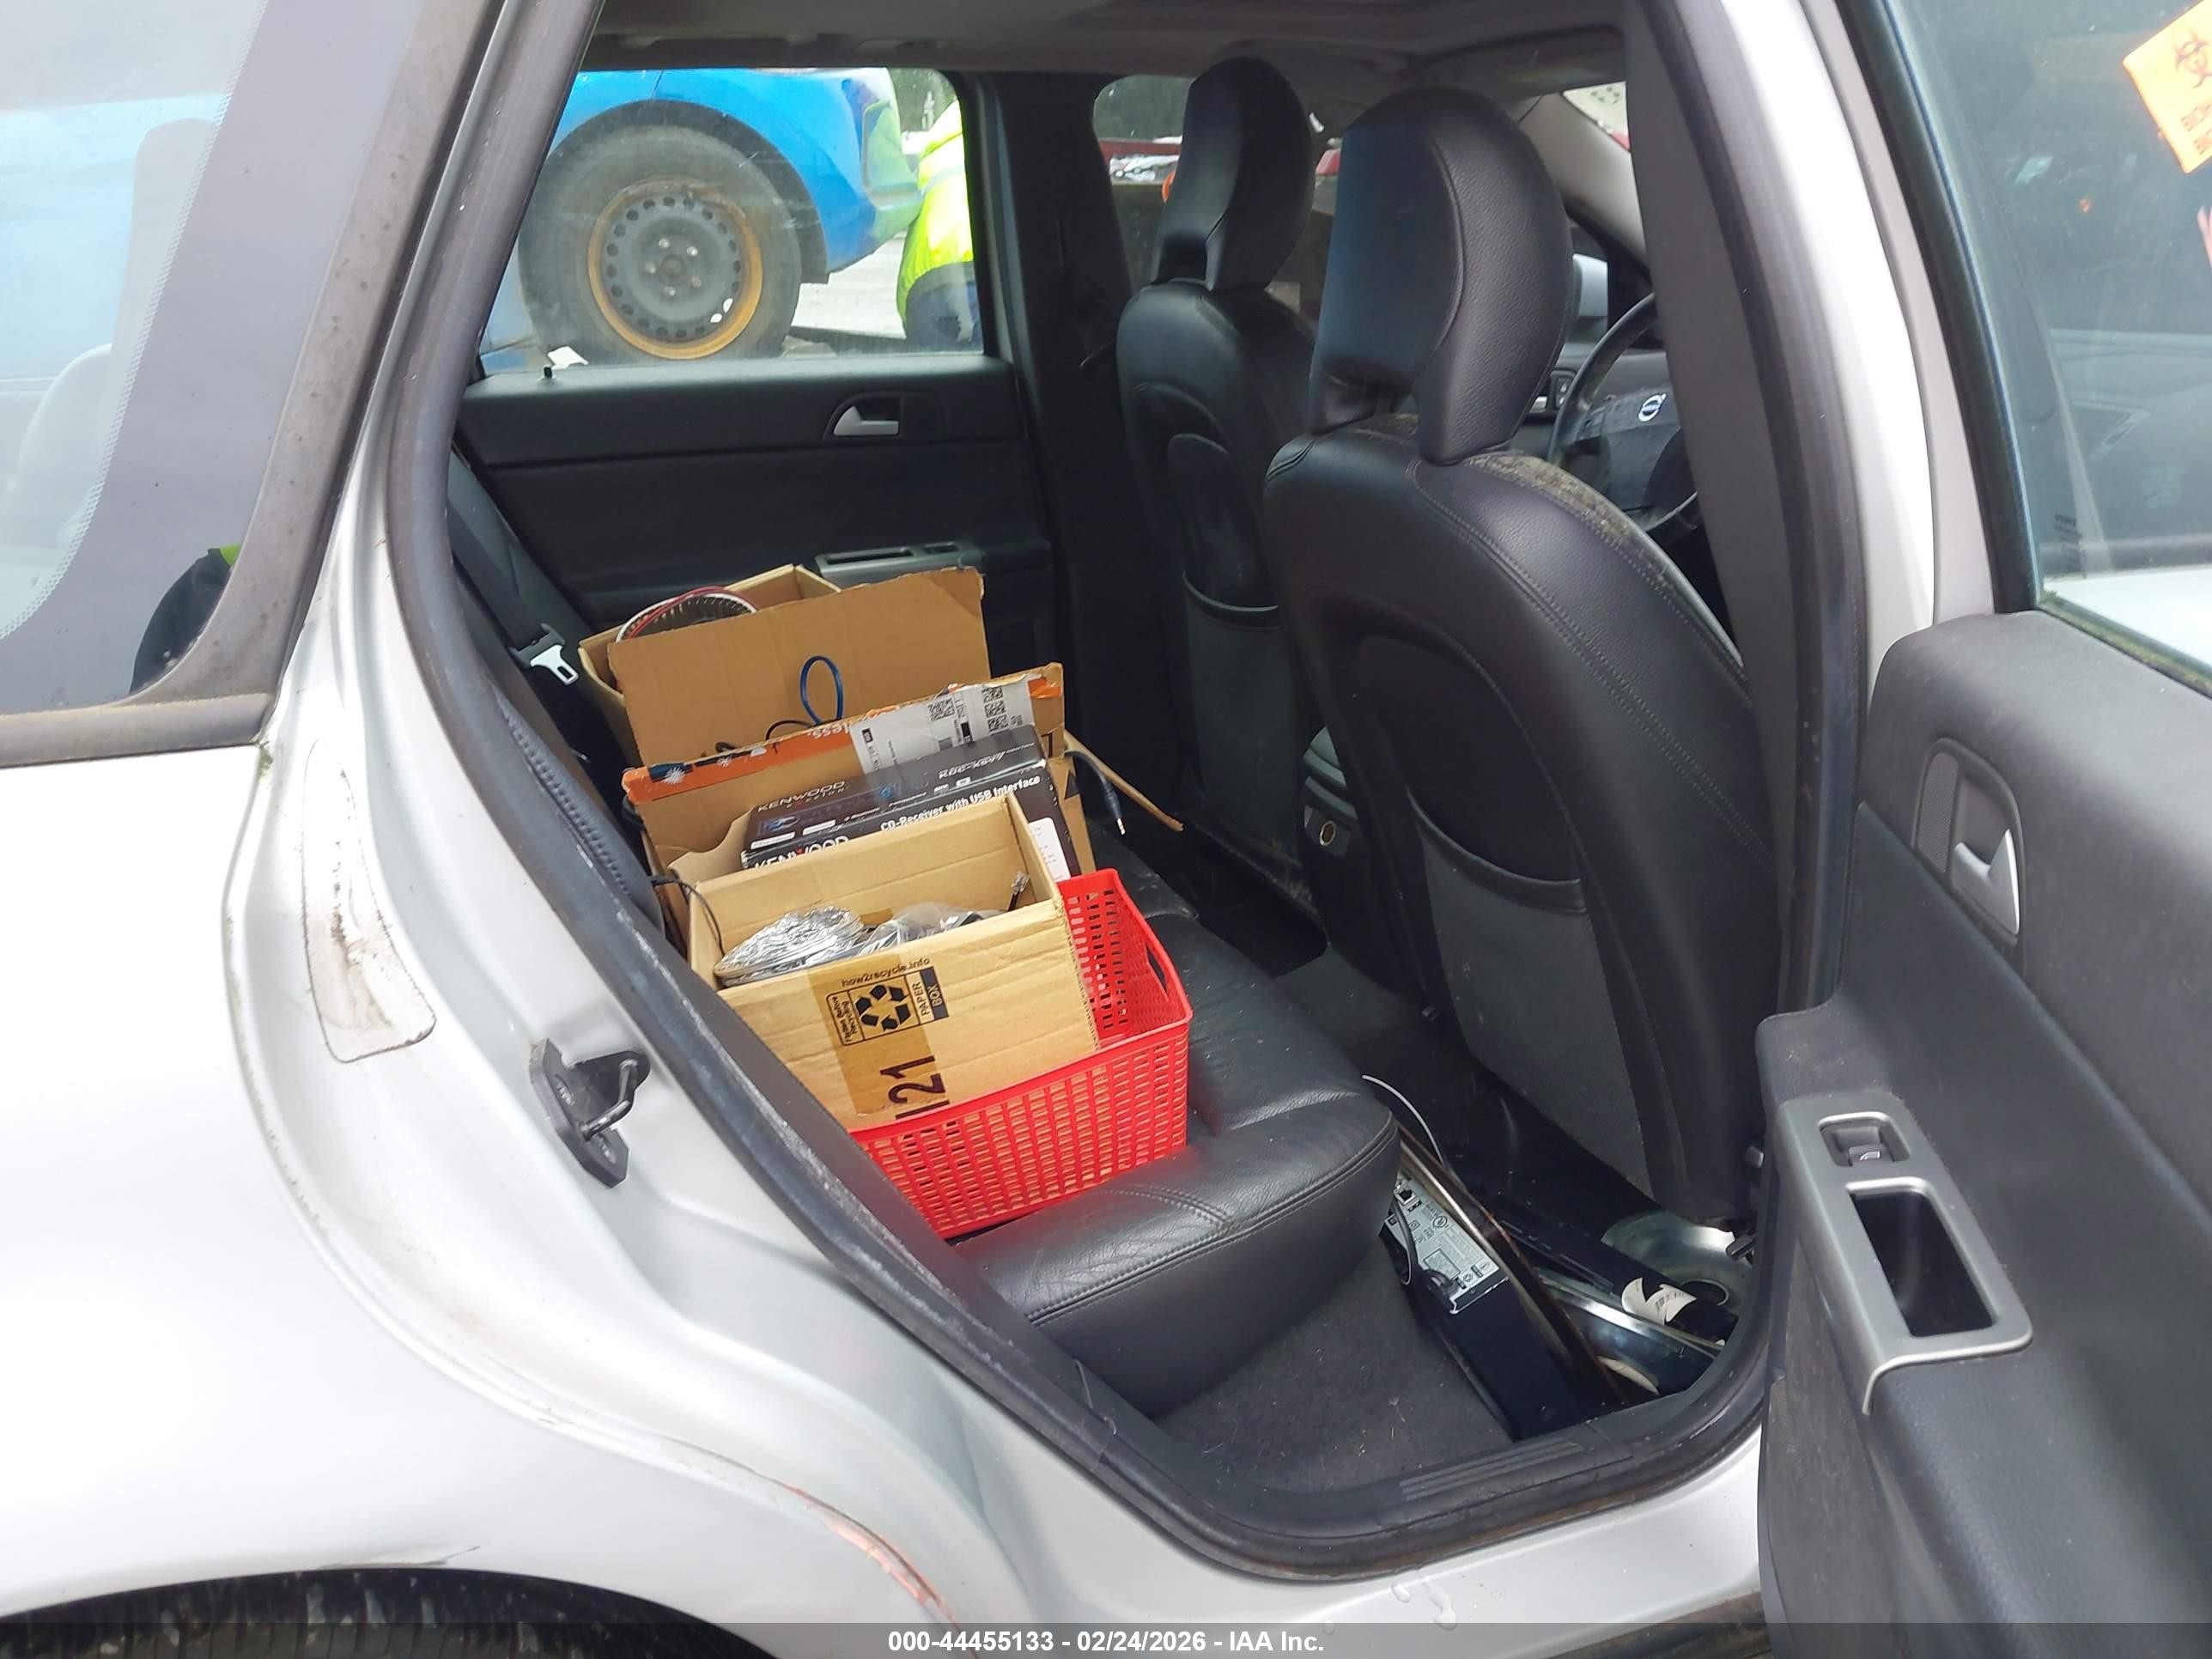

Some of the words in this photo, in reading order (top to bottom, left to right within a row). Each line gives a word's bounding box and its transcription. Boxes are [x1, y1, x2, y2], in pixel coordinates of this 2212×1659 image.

[757, 781, 846, 812] KENWOOD
[880, 805, 944, 832] CD-Receiver
[945, 796, 969, 812] with
[969, 787, 992, 805] USB
[994, 775, 1041, 797] Interface
[912, 981, 931, 1016] PAPER
[927, 983, 943, 1007] BOX
